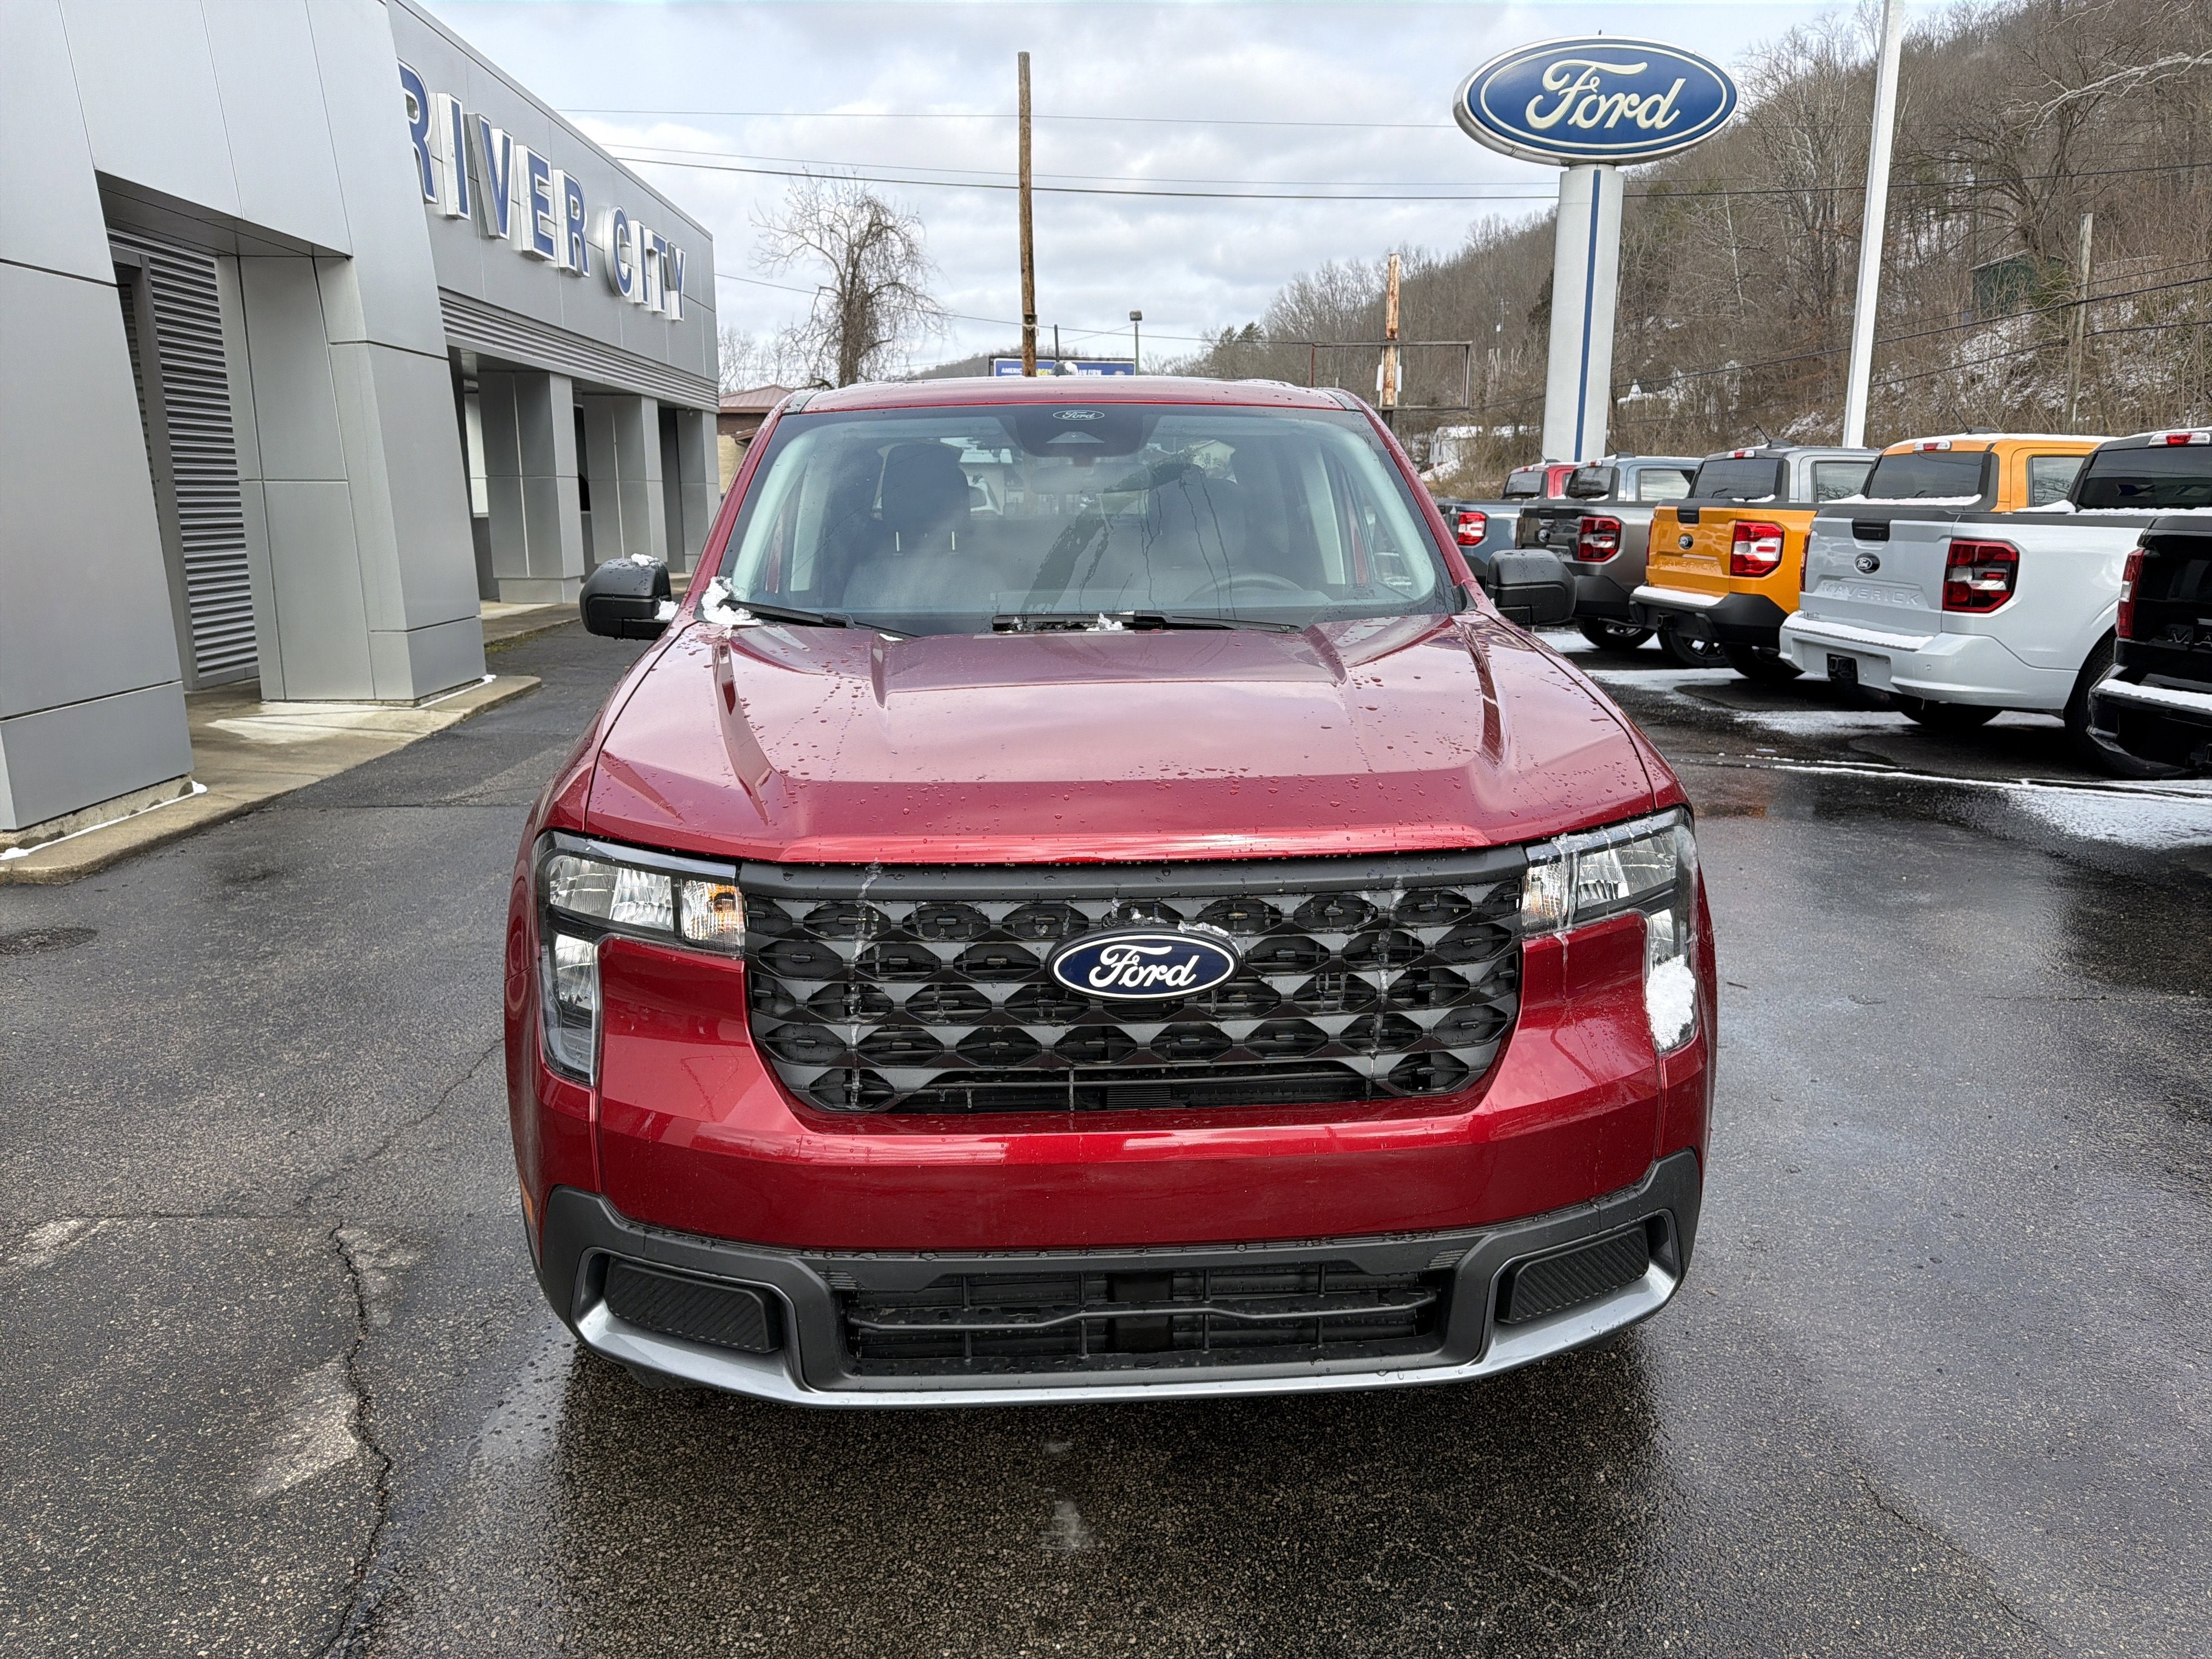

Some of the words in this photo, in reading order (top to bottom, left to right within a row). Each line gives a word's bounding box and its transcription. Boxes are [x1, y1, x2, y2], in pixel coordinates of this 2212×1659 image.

[1526, 59, 1686, 130] Ford
[397, 57, 590, 277] RIVER
[603, 205, 686, 321] CITY
[1062, 410, 1096, 419] Ford
[1822, 582, 1920, 605] MAVERICK
[1088, 944, 1200, 987] Ford
